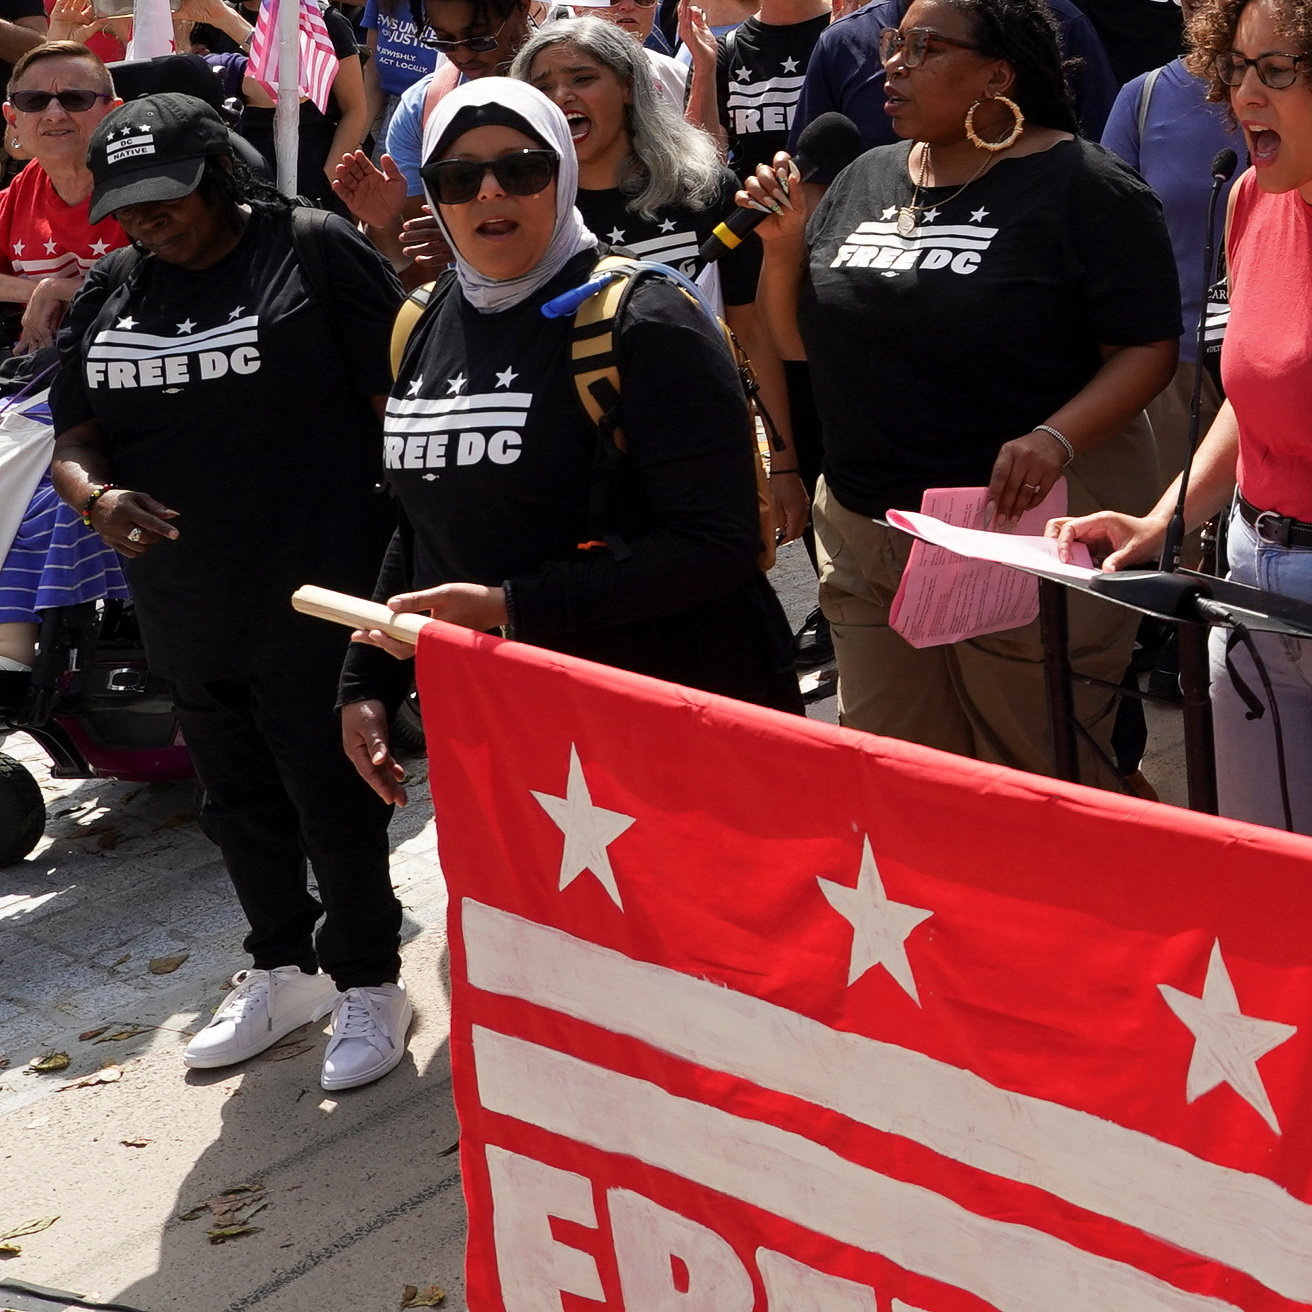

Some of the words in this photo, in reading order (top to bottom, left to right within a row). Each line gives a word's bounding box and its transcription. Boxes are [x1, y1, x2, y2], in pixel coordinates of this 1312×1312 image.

[377, 14, 399, 30] EWS
[379, 57, 394, 67] ACT
[396, 61, 428, 74] LOCALLY.
[120, 138, 133, 147] DC
[113, 147, 148, 160] NATIVE
[830, 244, 922, 270] FREE
[918, 249, 982, 276] DC
[86, 355, 190, 389] FREE
[199, 346, 261, 380] DC
[384, 434, 449, 470] REE
[457, 430, 523, 466] DC
